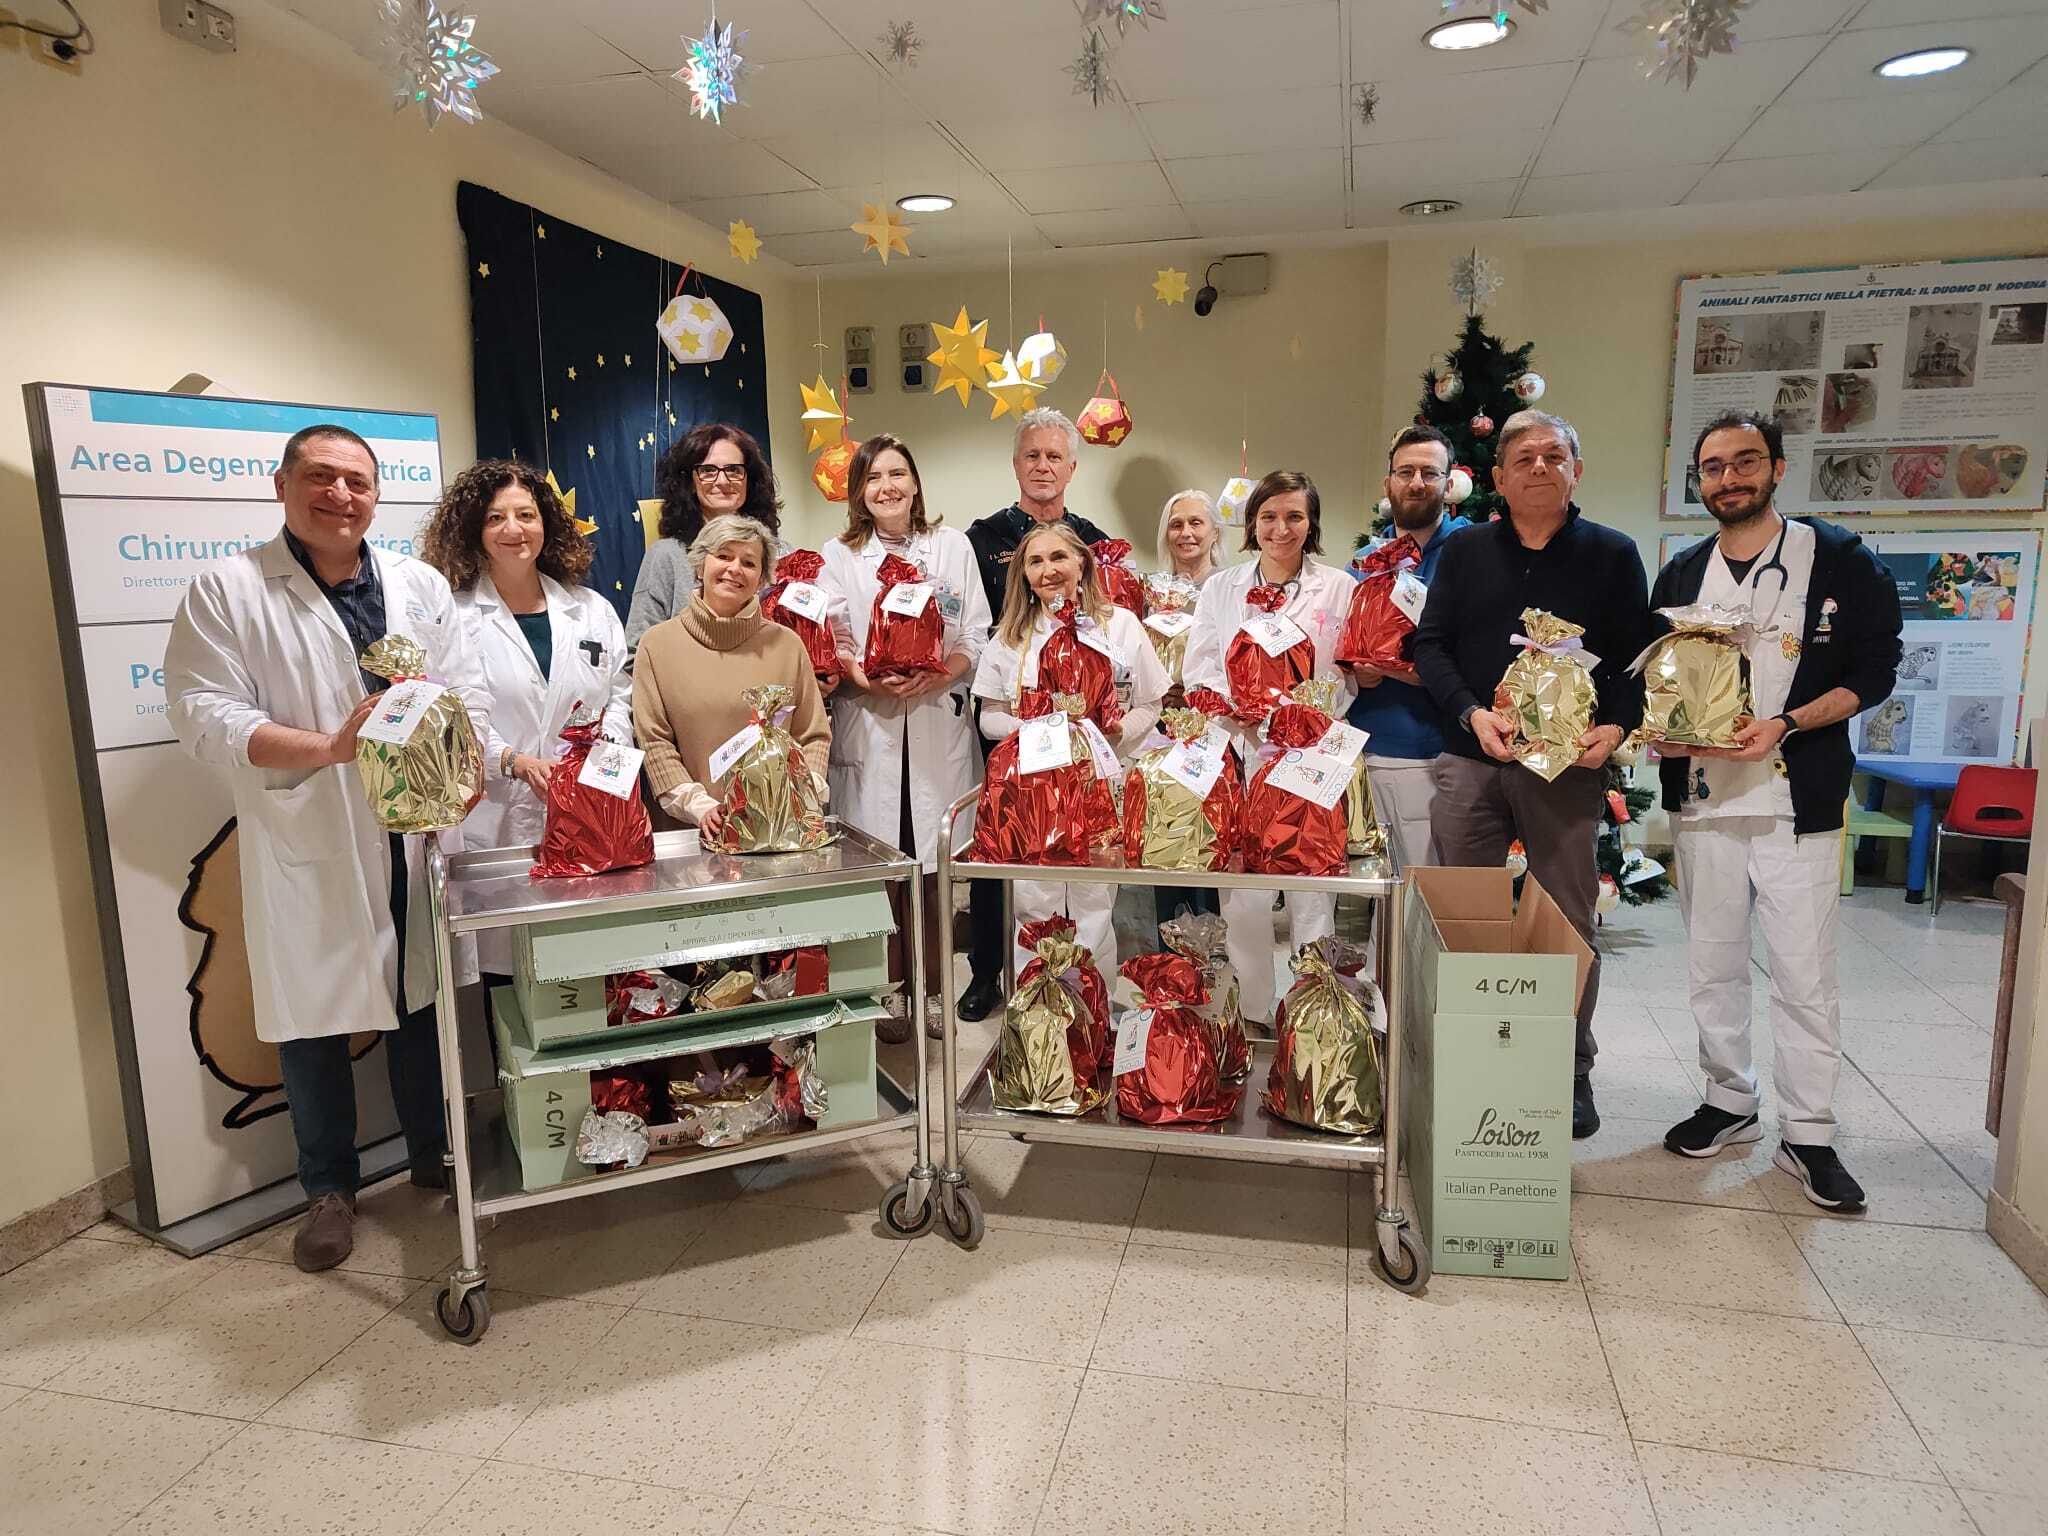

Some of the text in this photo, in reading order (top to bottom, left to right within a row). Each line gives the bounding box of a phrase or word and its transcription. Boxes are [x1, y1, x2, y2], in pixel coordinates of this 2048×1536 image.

[1698, 279, 2048, 308] ANIMALI FANTASTICI NELLA PIETRA: IL DUOMO DI MODENA
[70, 445, 432, 482] Area Degenz trica
[123, 575, 187, 588] Direttore
[558, 983, 579, 1010] /M
[1475, 977, 1537, 996] 4 C/M
[545, 1090, 567, 1149] 4 C/M
[1460, 1107, 1542, 1147] Loison
[1445, 1181, 1557, 1198] Italian Panettone
